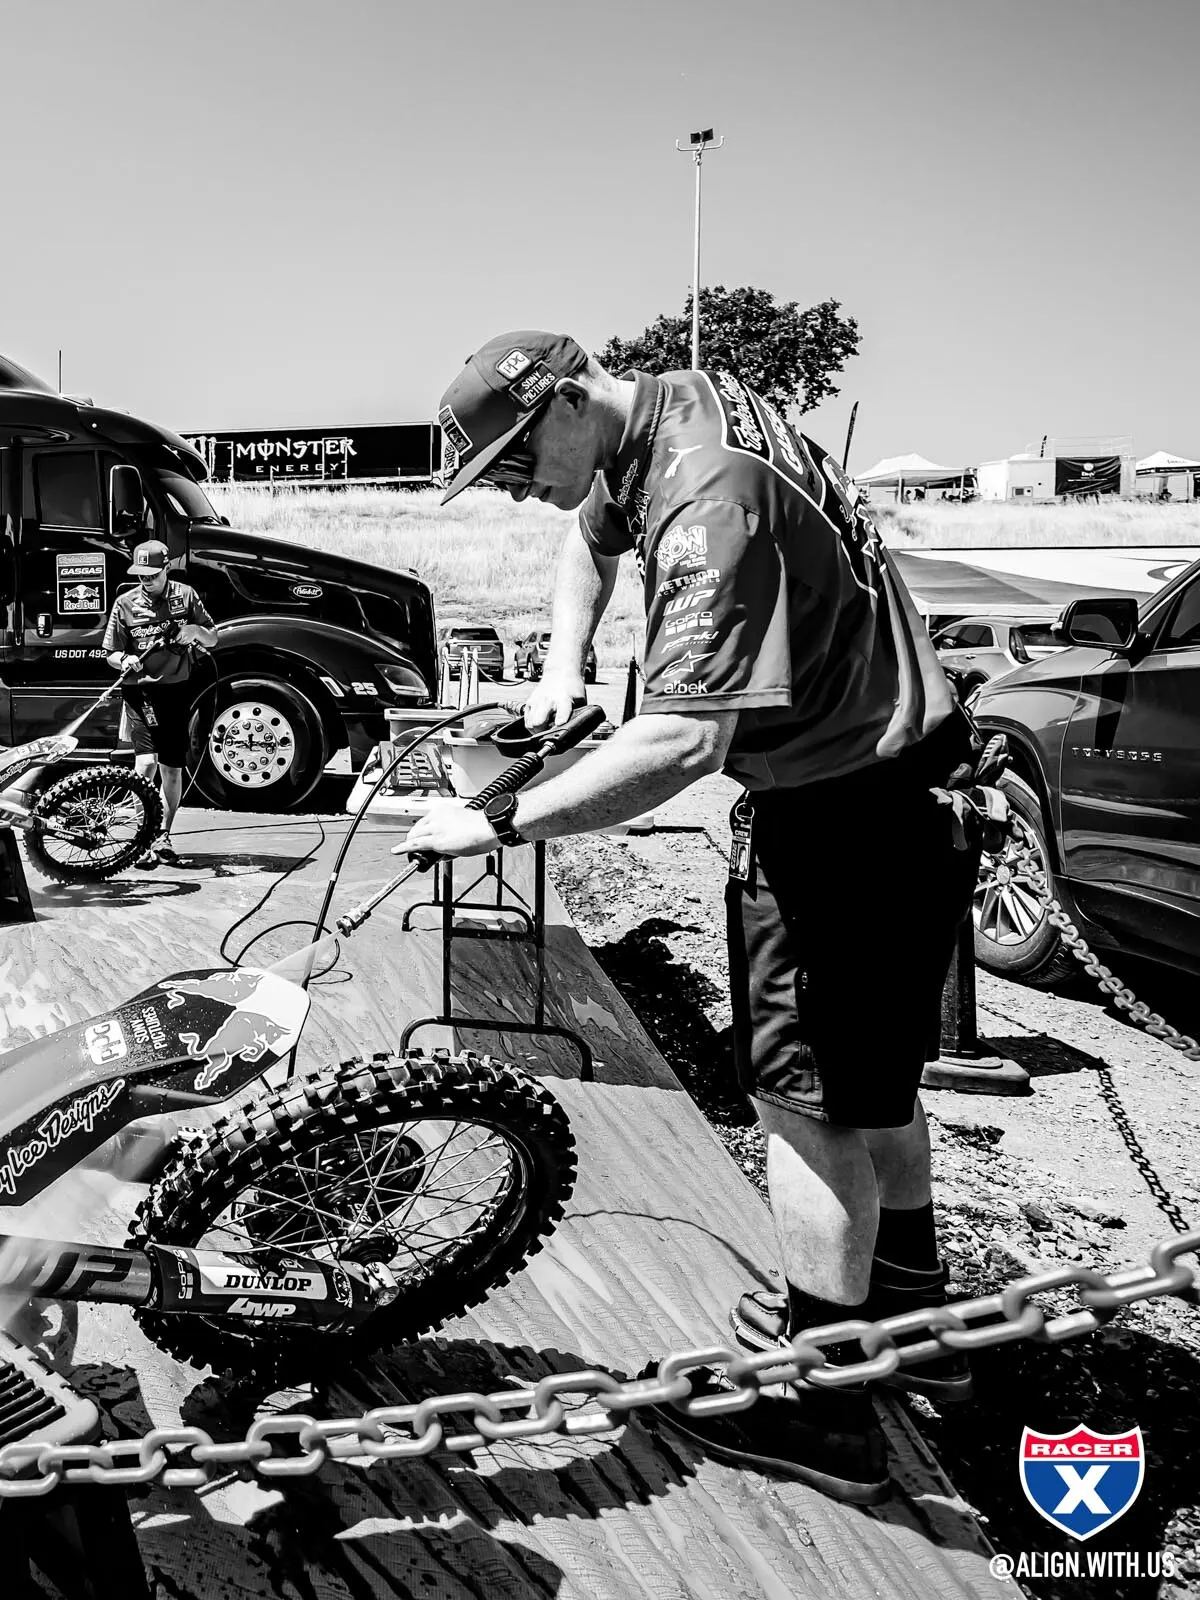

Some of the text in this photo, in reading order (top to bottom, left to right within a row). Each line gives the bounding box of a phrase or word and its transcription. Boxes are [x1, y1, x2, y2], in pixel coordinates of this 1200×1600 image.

[521, 370, 542, 390] SONY
[521, 372, 556, 404] PICTURES
[236, 438, 358, 460] MONSTER
[256, 462, 340, 473] ENERGY
[60, 567, 103, 575] GASGAS
[64, 599, 100, 610] Red Bull
[54, 650, 68, 659] US
[68, 650, 86, 659] DOT
[351, 682, 378, 695] 25
[131, 1018, 149, 1044] SONY
[142, 1006, 168, 1050] PICTURES
[8, 1140, 47, 1176] Lee
[38, 1079, 125, 1147] Designs
[223, 1274, 312, 1292] DUNLOP
